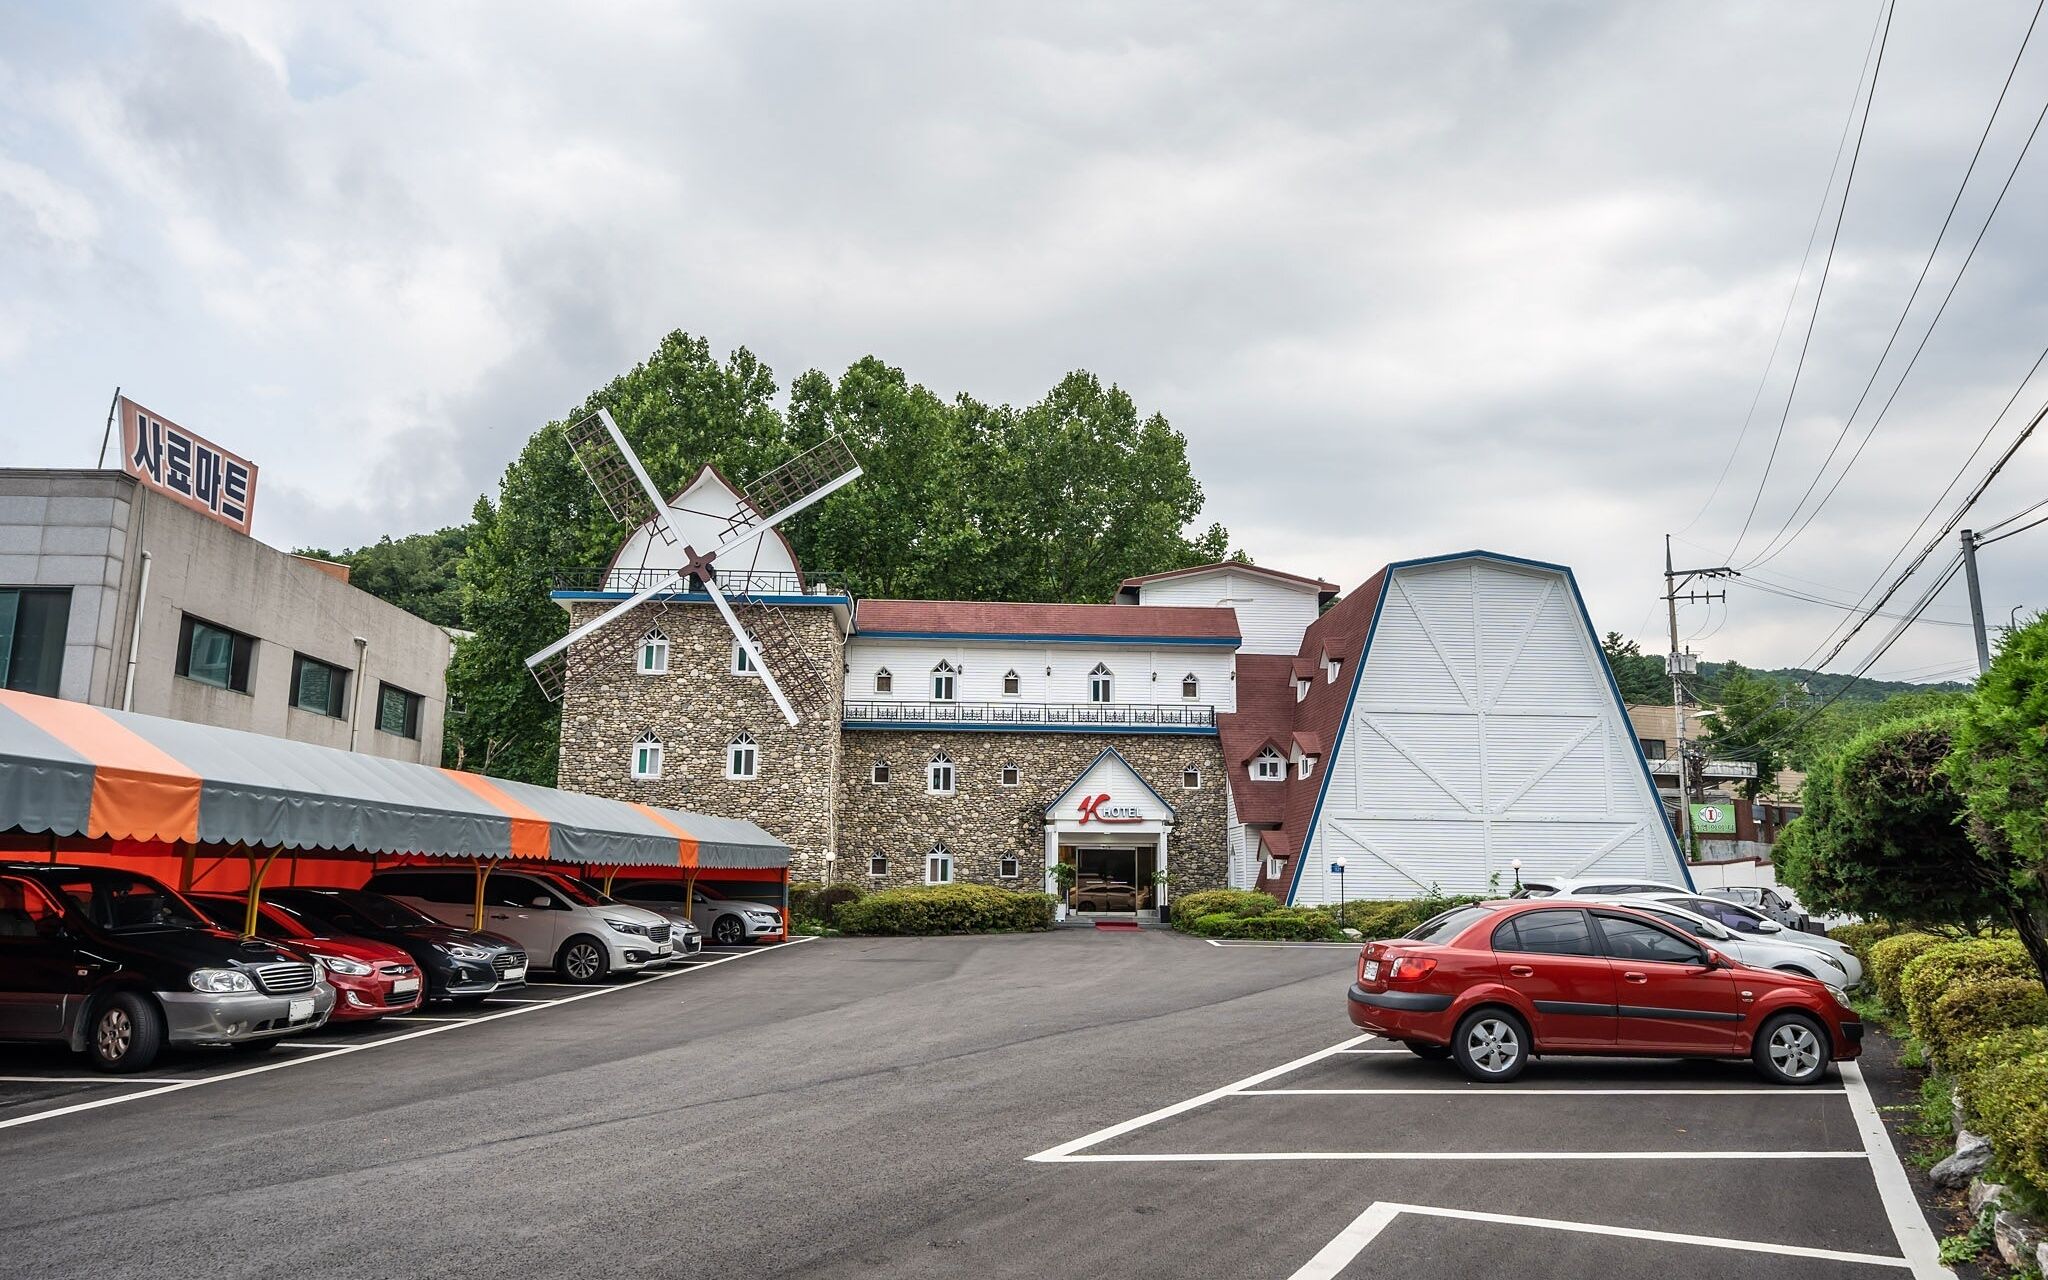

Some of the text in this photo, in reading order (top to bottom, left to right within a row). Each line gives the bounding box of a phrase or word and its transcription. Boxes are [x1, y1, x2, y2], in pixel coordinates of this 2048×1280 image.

[133, 412, 249, 524] 사료마트
[1078, 794, 1143, 825] K HOTEL
